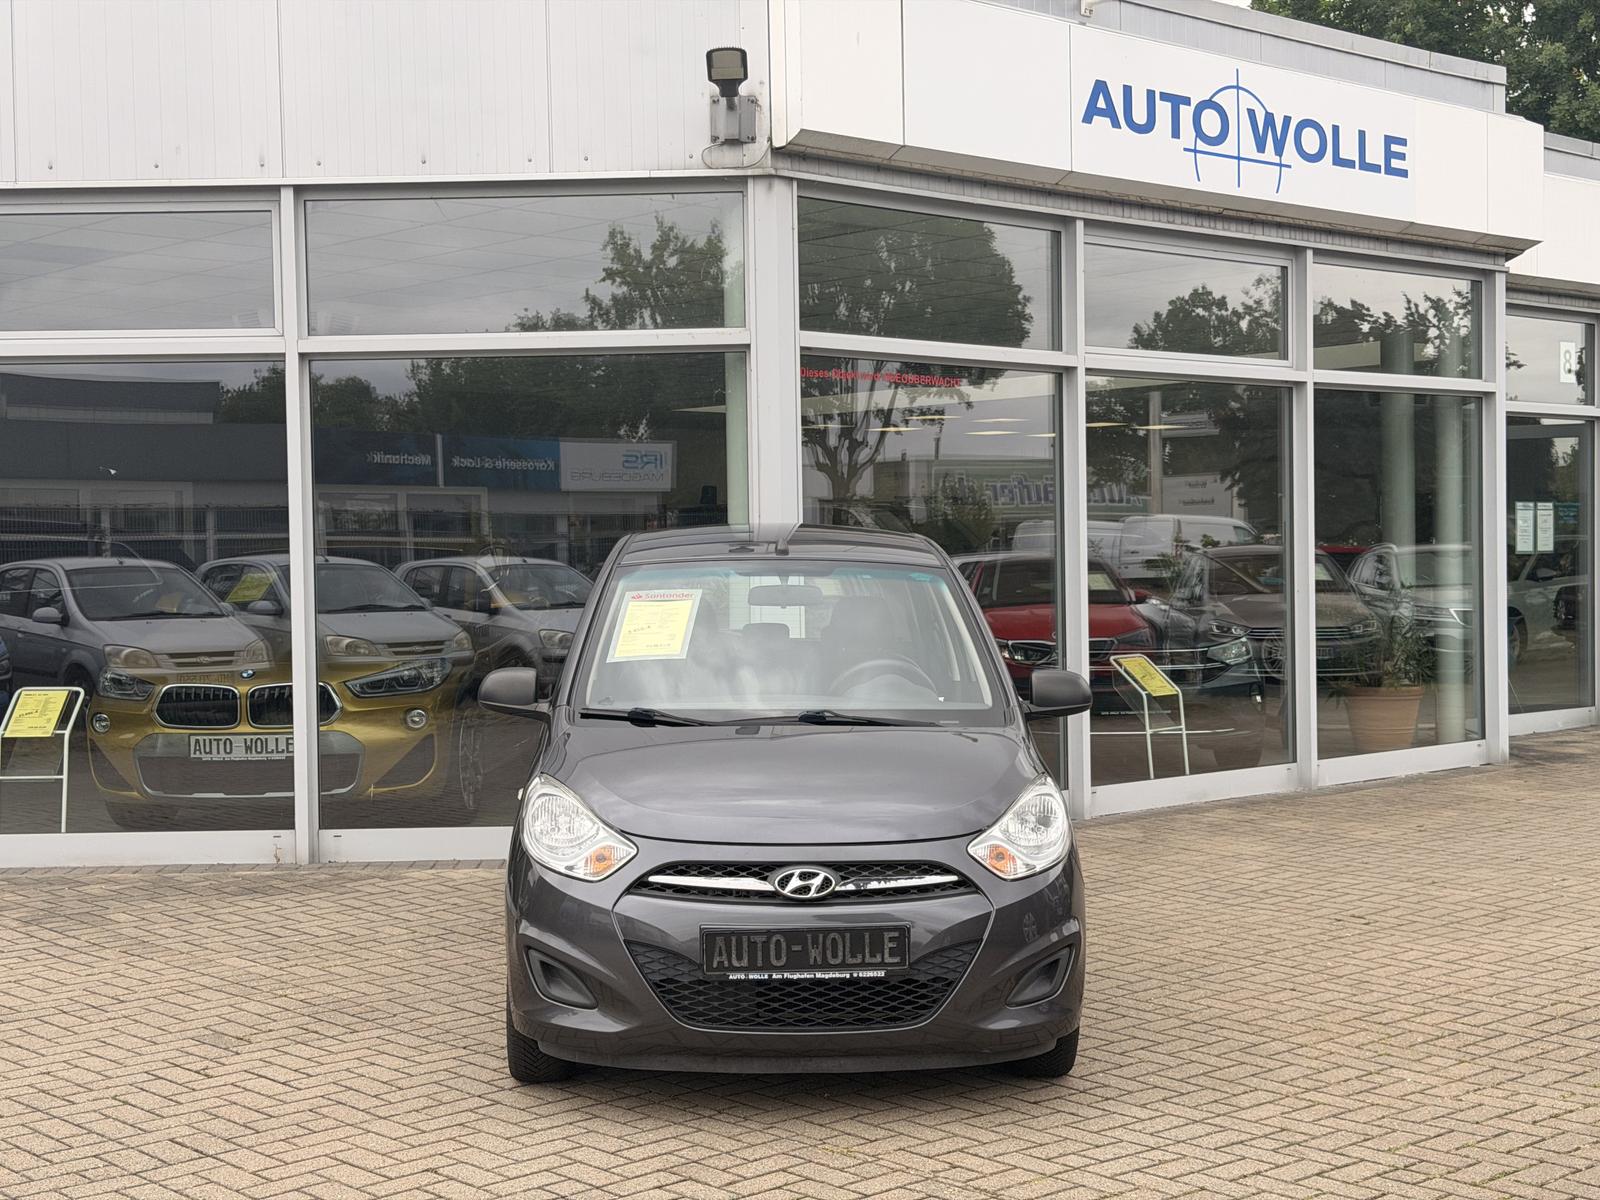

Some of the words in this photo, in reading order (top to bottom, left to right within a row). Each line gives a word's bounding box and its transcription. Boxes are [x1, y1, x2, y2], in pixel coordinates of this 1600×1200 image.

[1081, 79, 1229, 146] AUTO
[1246, 108, 1408, 178] WOLLE
[1563, 349, 1572, 375] 8
[800, 367, 829, 378] Dieses
[645, 592, 695, 600] Santander
